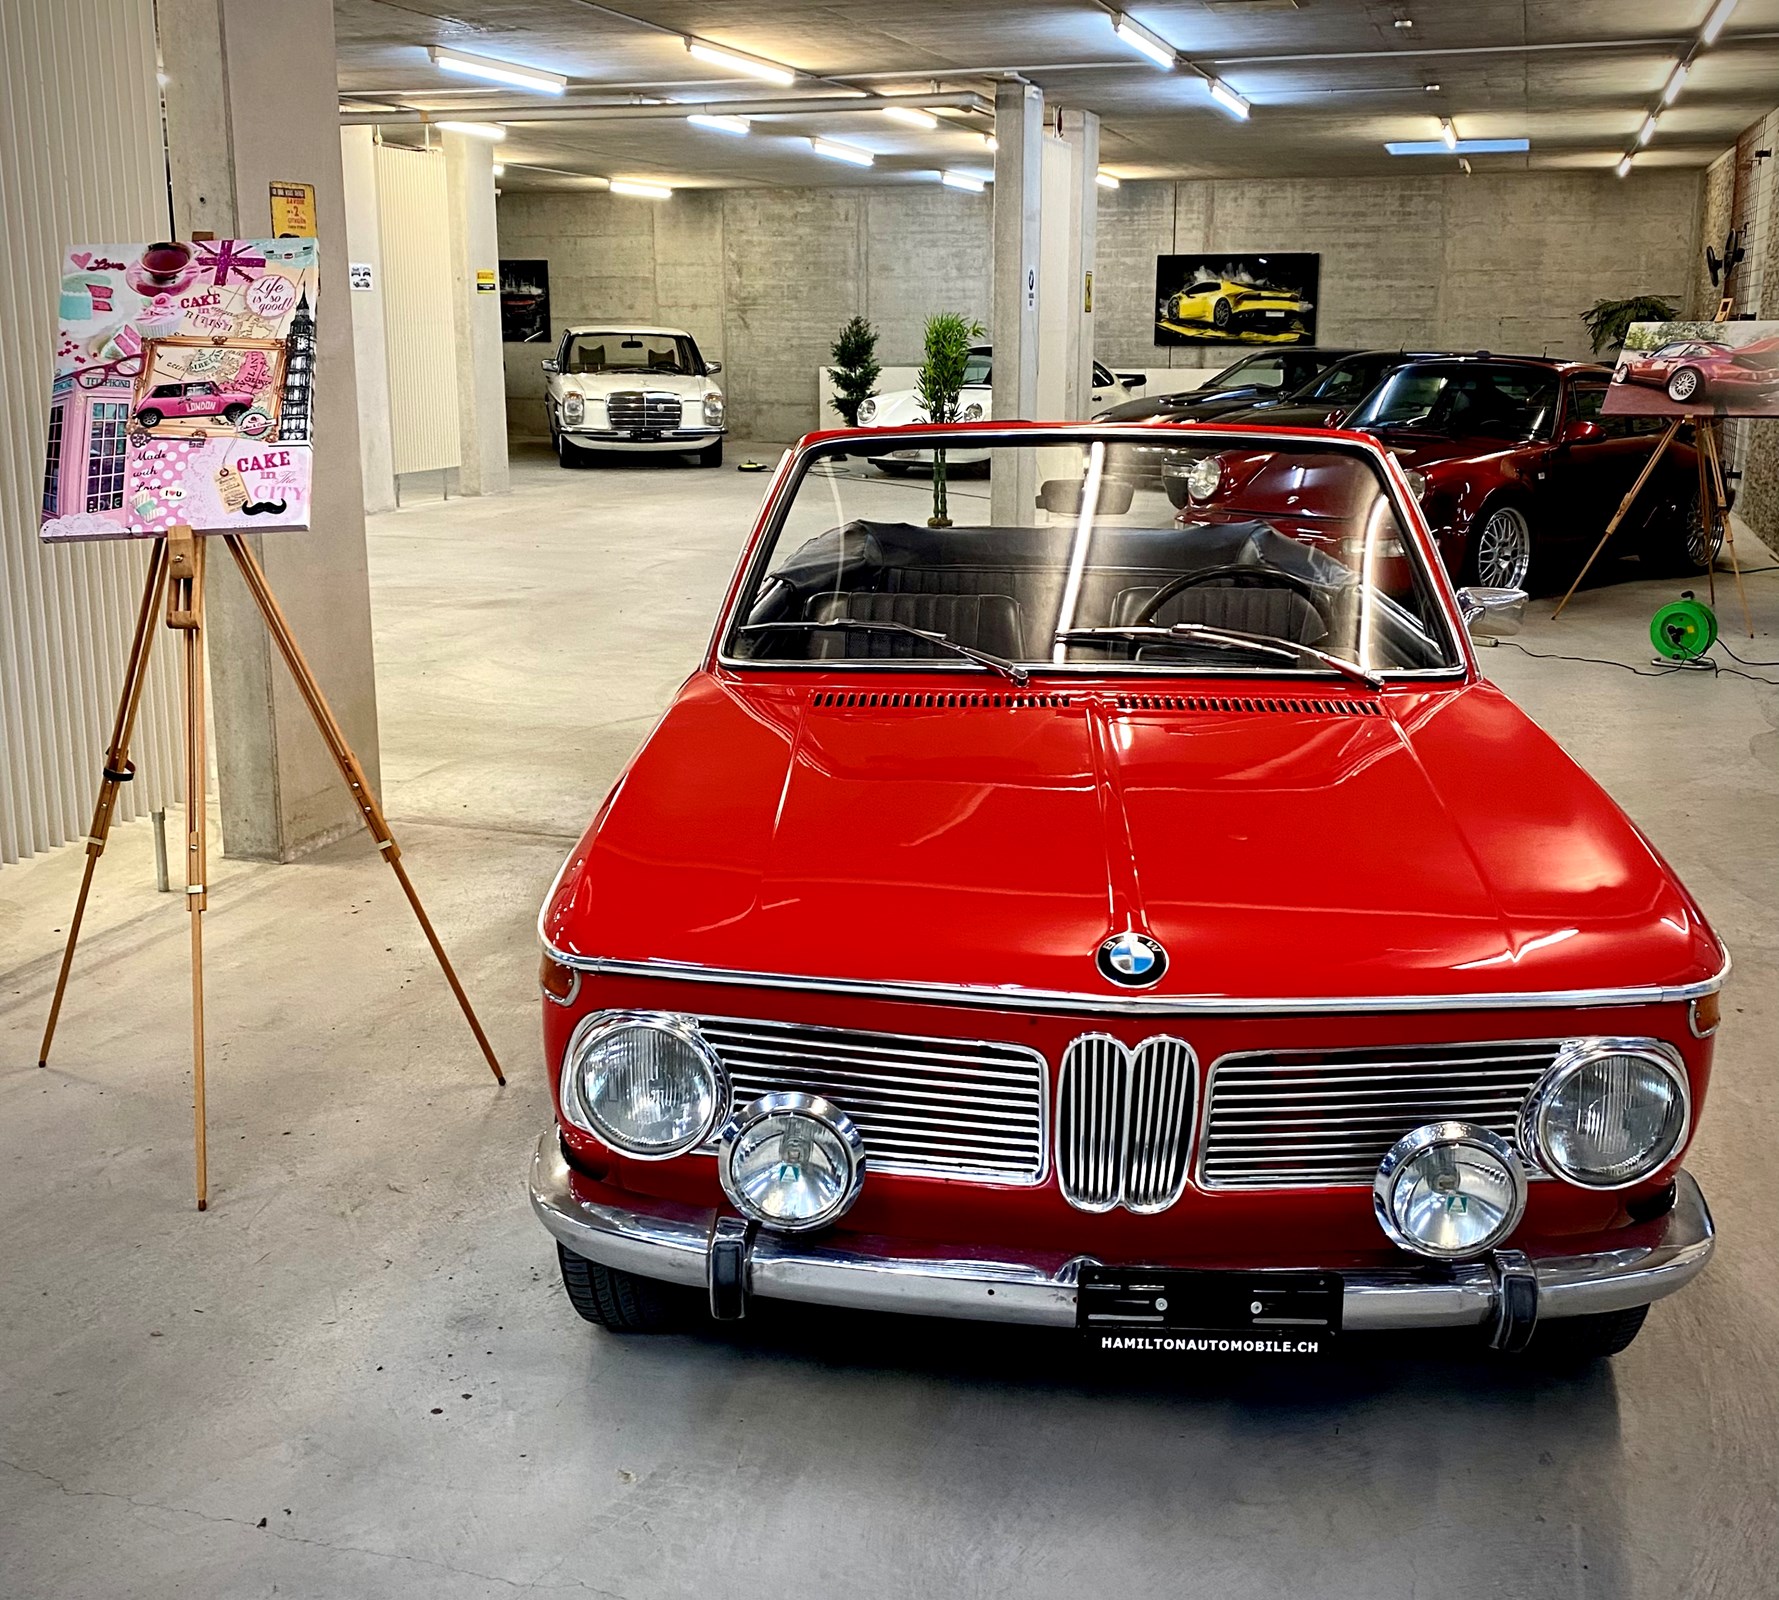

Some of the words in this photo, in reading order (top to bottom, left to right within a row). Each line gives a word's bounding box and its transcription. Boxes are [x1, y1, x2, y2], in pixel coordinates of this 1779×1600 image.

[86, 258, 127, 271] Love
[253, 276, 284, 298] Life
[180, 294, 221, 309] CAKE
[252, 295, 262, 304] is
[270, 295, 282, 303] so
[185, 401, 217, 412] LONDON
[132, 450, 167, 462] Made
[236, 451, 291, 473] CAKE
[132, 466, 158, 477] with
[260, 471, 276, 480] in
[274, 471, 297, 484] The
[135, 481, 163, 493] Love
[253, 484, 306, 501] CITY
[1101, 1337, 1319, 1353] HAMILTONAUTOMOBILE.CH
